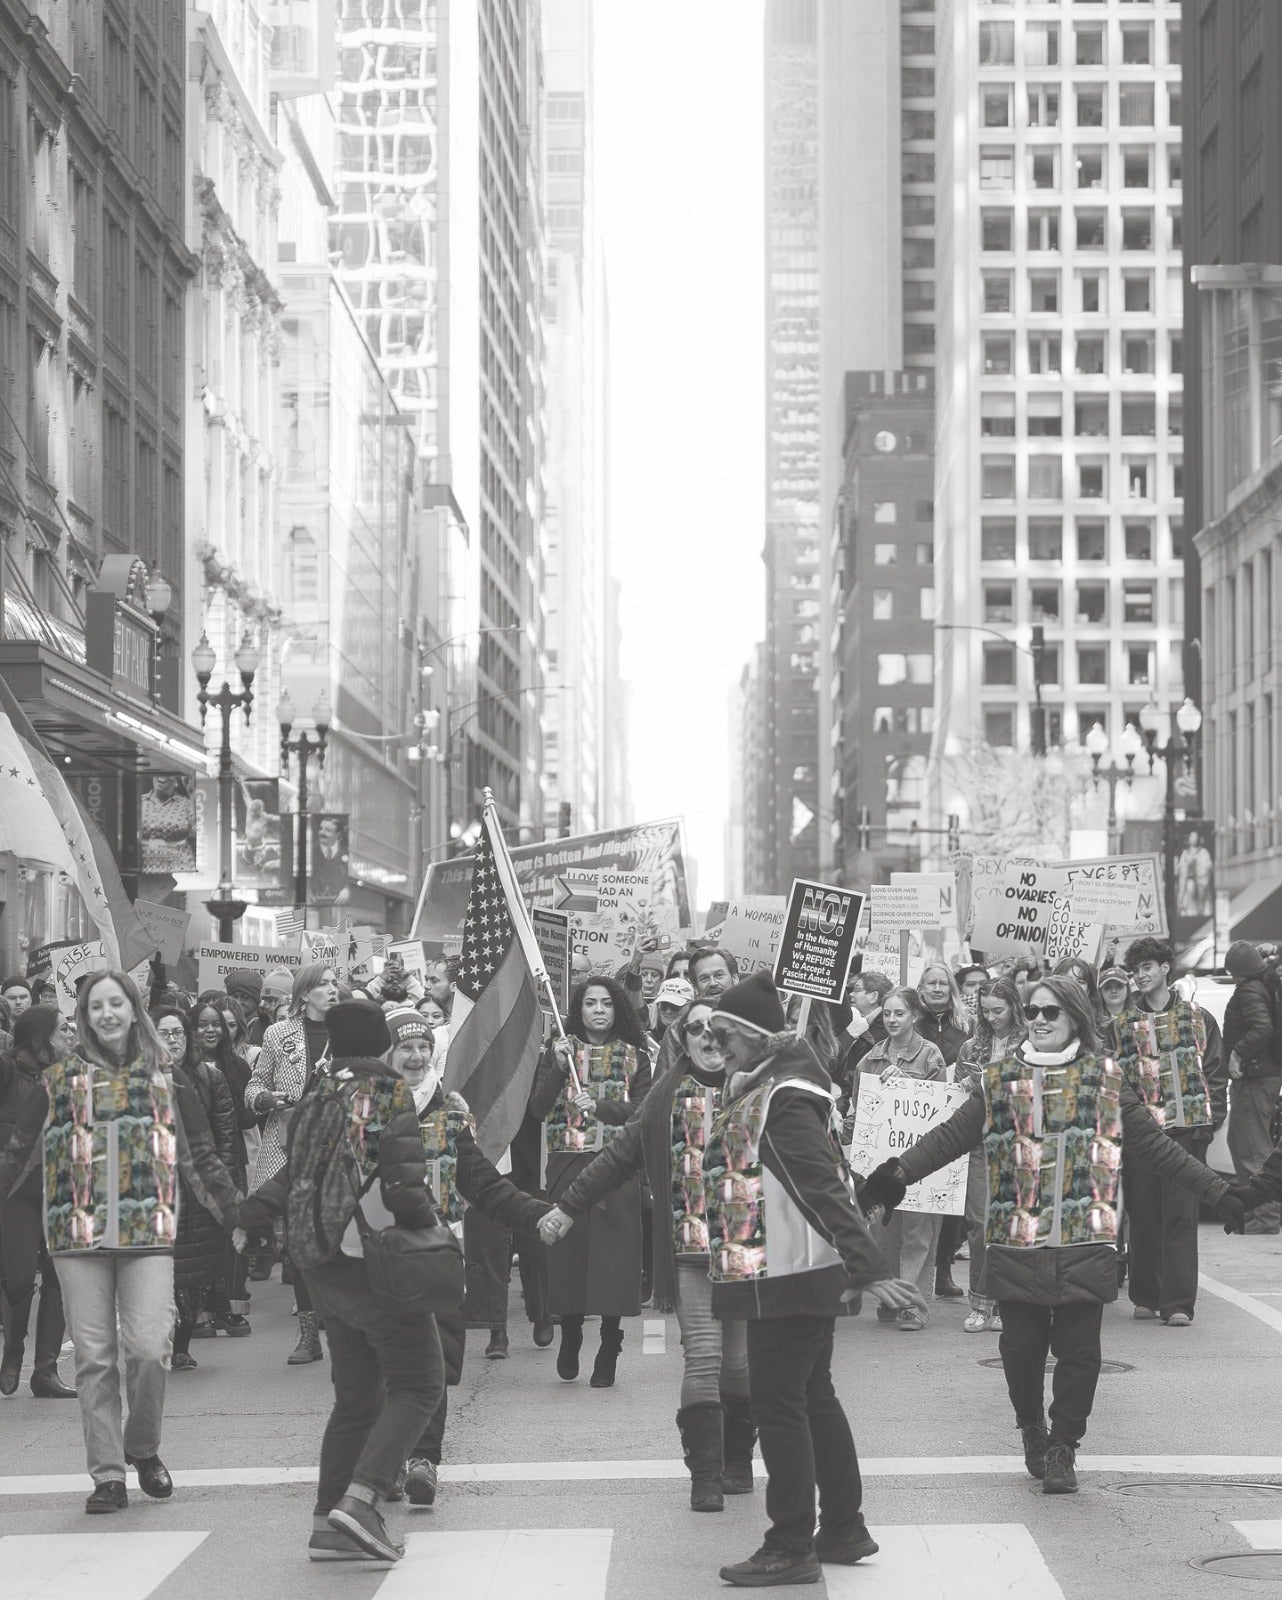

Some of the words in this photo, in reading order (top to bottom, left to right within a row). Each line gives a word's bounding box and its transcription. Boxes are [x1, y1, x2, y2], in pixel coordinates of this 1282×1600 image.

[546, 850, 582, 868] Rotten
[582, 844, 605, 861] And
[602, 874, 649, 885] SOMEONE
[1020, 872, 1037, 887] NO
[517, 882, 532, 897] eed
[618, 887, 633, 897] AN
[1005, 886, 1057, 904] OVARIES
[731, 905, 739, 917] A
[797, 887, 851, 938] NO!
[1018, 906, 1038, 923] NO
[550, 929, 566, 942] Name
[570, 928, 608, 943] RTION
[770, 929, 780, 940] IS
[797, 929, 805, 941] In
[805, 931, 817, 943] the
[818, 934, 840, 948] Name
[1050, 923, 1085, 939] OVER
[748, 938, 760, 949] IN
[794, 940, 804, 950] of
[803, 941, 838, 959] Humanity
[63, 944, 92, 967] RISE
[200, 948, 260, 962] EMPOWERED
[265, 954, 302, 966] WOMEN
[312, 946, 339, 961] STAND
[792, 949, 804, 961] We
[805, 952, 836, 968] REFUSE
[781, 966, 808, 980] Fascist
[807, 974, 838, 987] America
[791, 960, 800, 969] to
[800, 961, 826, 977] Accept
[894, 1099, 940, 1122] PUSSY
